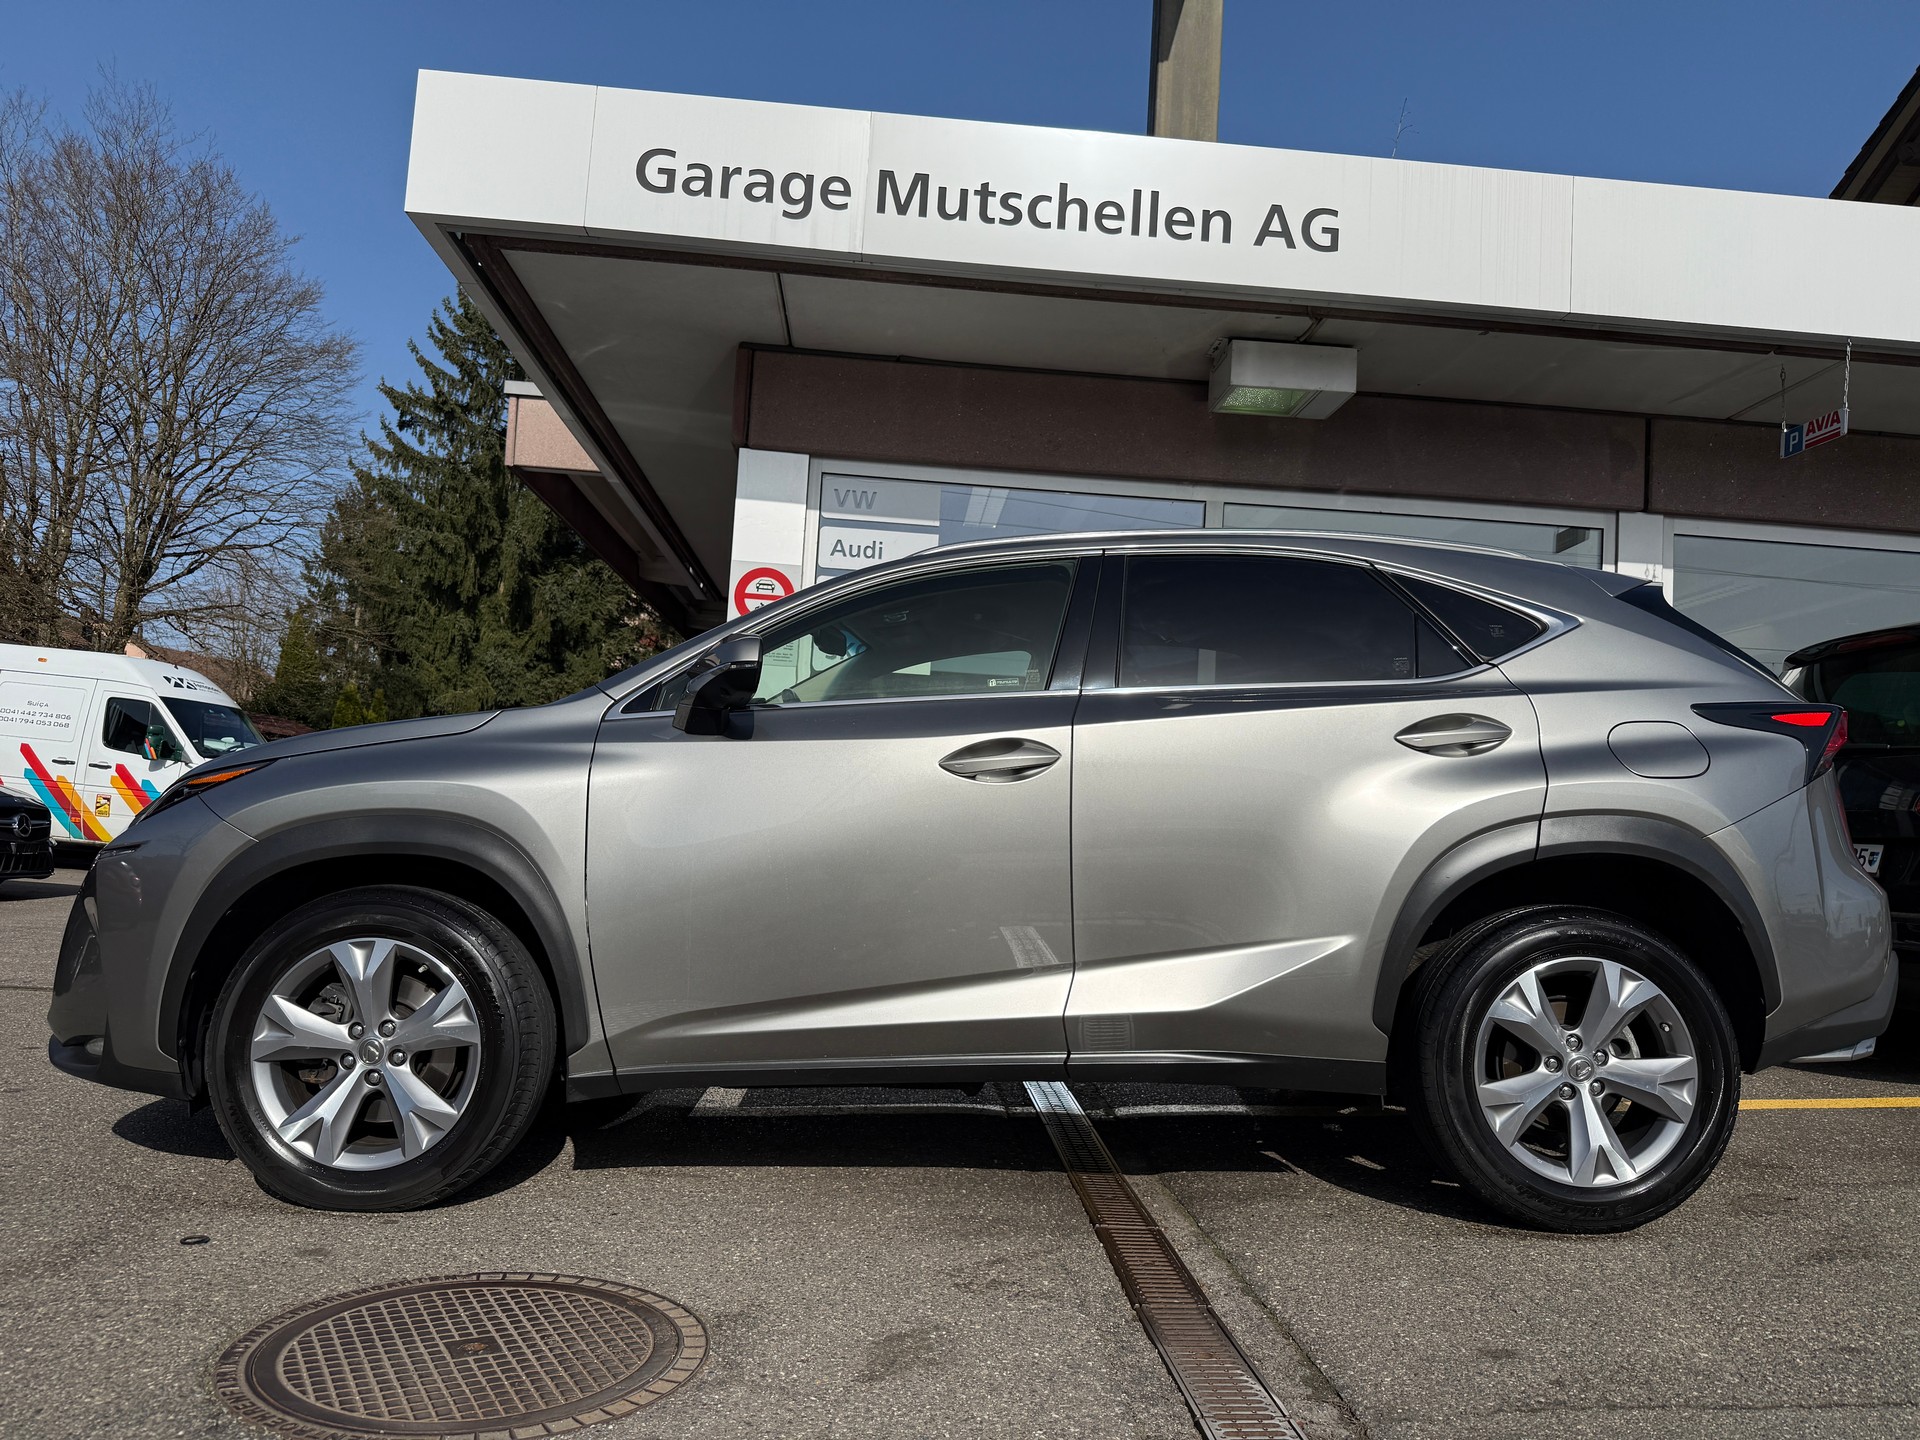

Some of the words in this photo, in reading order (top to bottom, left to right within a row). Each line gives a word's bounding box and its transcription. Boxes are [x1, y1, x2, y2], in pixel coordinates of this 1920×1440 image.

[636, 149, 851, 219] Garage
[877, 169, 1232, 244] Mutschellen
[1254, 204, 1340, 252] AG
[1789, 432, 1799, 453] P
[1805, 410, 1841, 437] AVIA
[833, 488, 878, 510] VW
[830, 539, 884, 560] Audi
